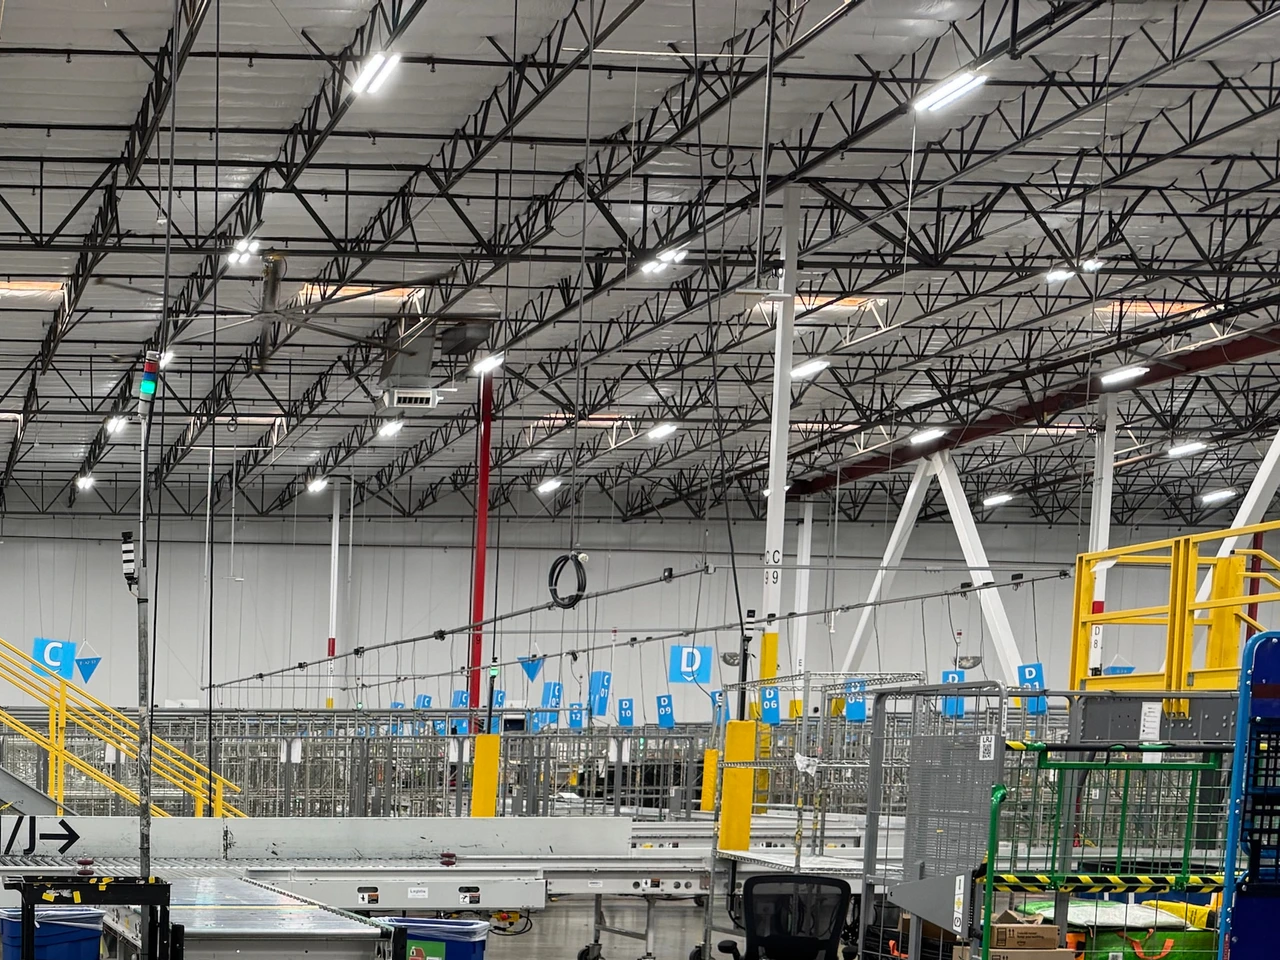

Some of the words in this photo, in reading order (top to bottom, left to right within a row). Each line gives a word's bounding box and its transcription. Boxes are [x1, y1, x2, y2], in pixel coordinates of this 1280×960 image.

[772, 550, 780, 564] C
[772, 570, 779, 584] 9
[1094, 626, 1100, 636] D
[43, 641, 63, 667] C
[680, 647, 701, 673] D
[1025, 667, 1036, 679] D
[766, 688, 774, 699] D
[622, 700, 630, 709] D
[661, 697, 669, 706] D
[763, 700, 778, 709] 06
[621, 710, 632, 718] 10
[659, 707, 671, 715] 09
